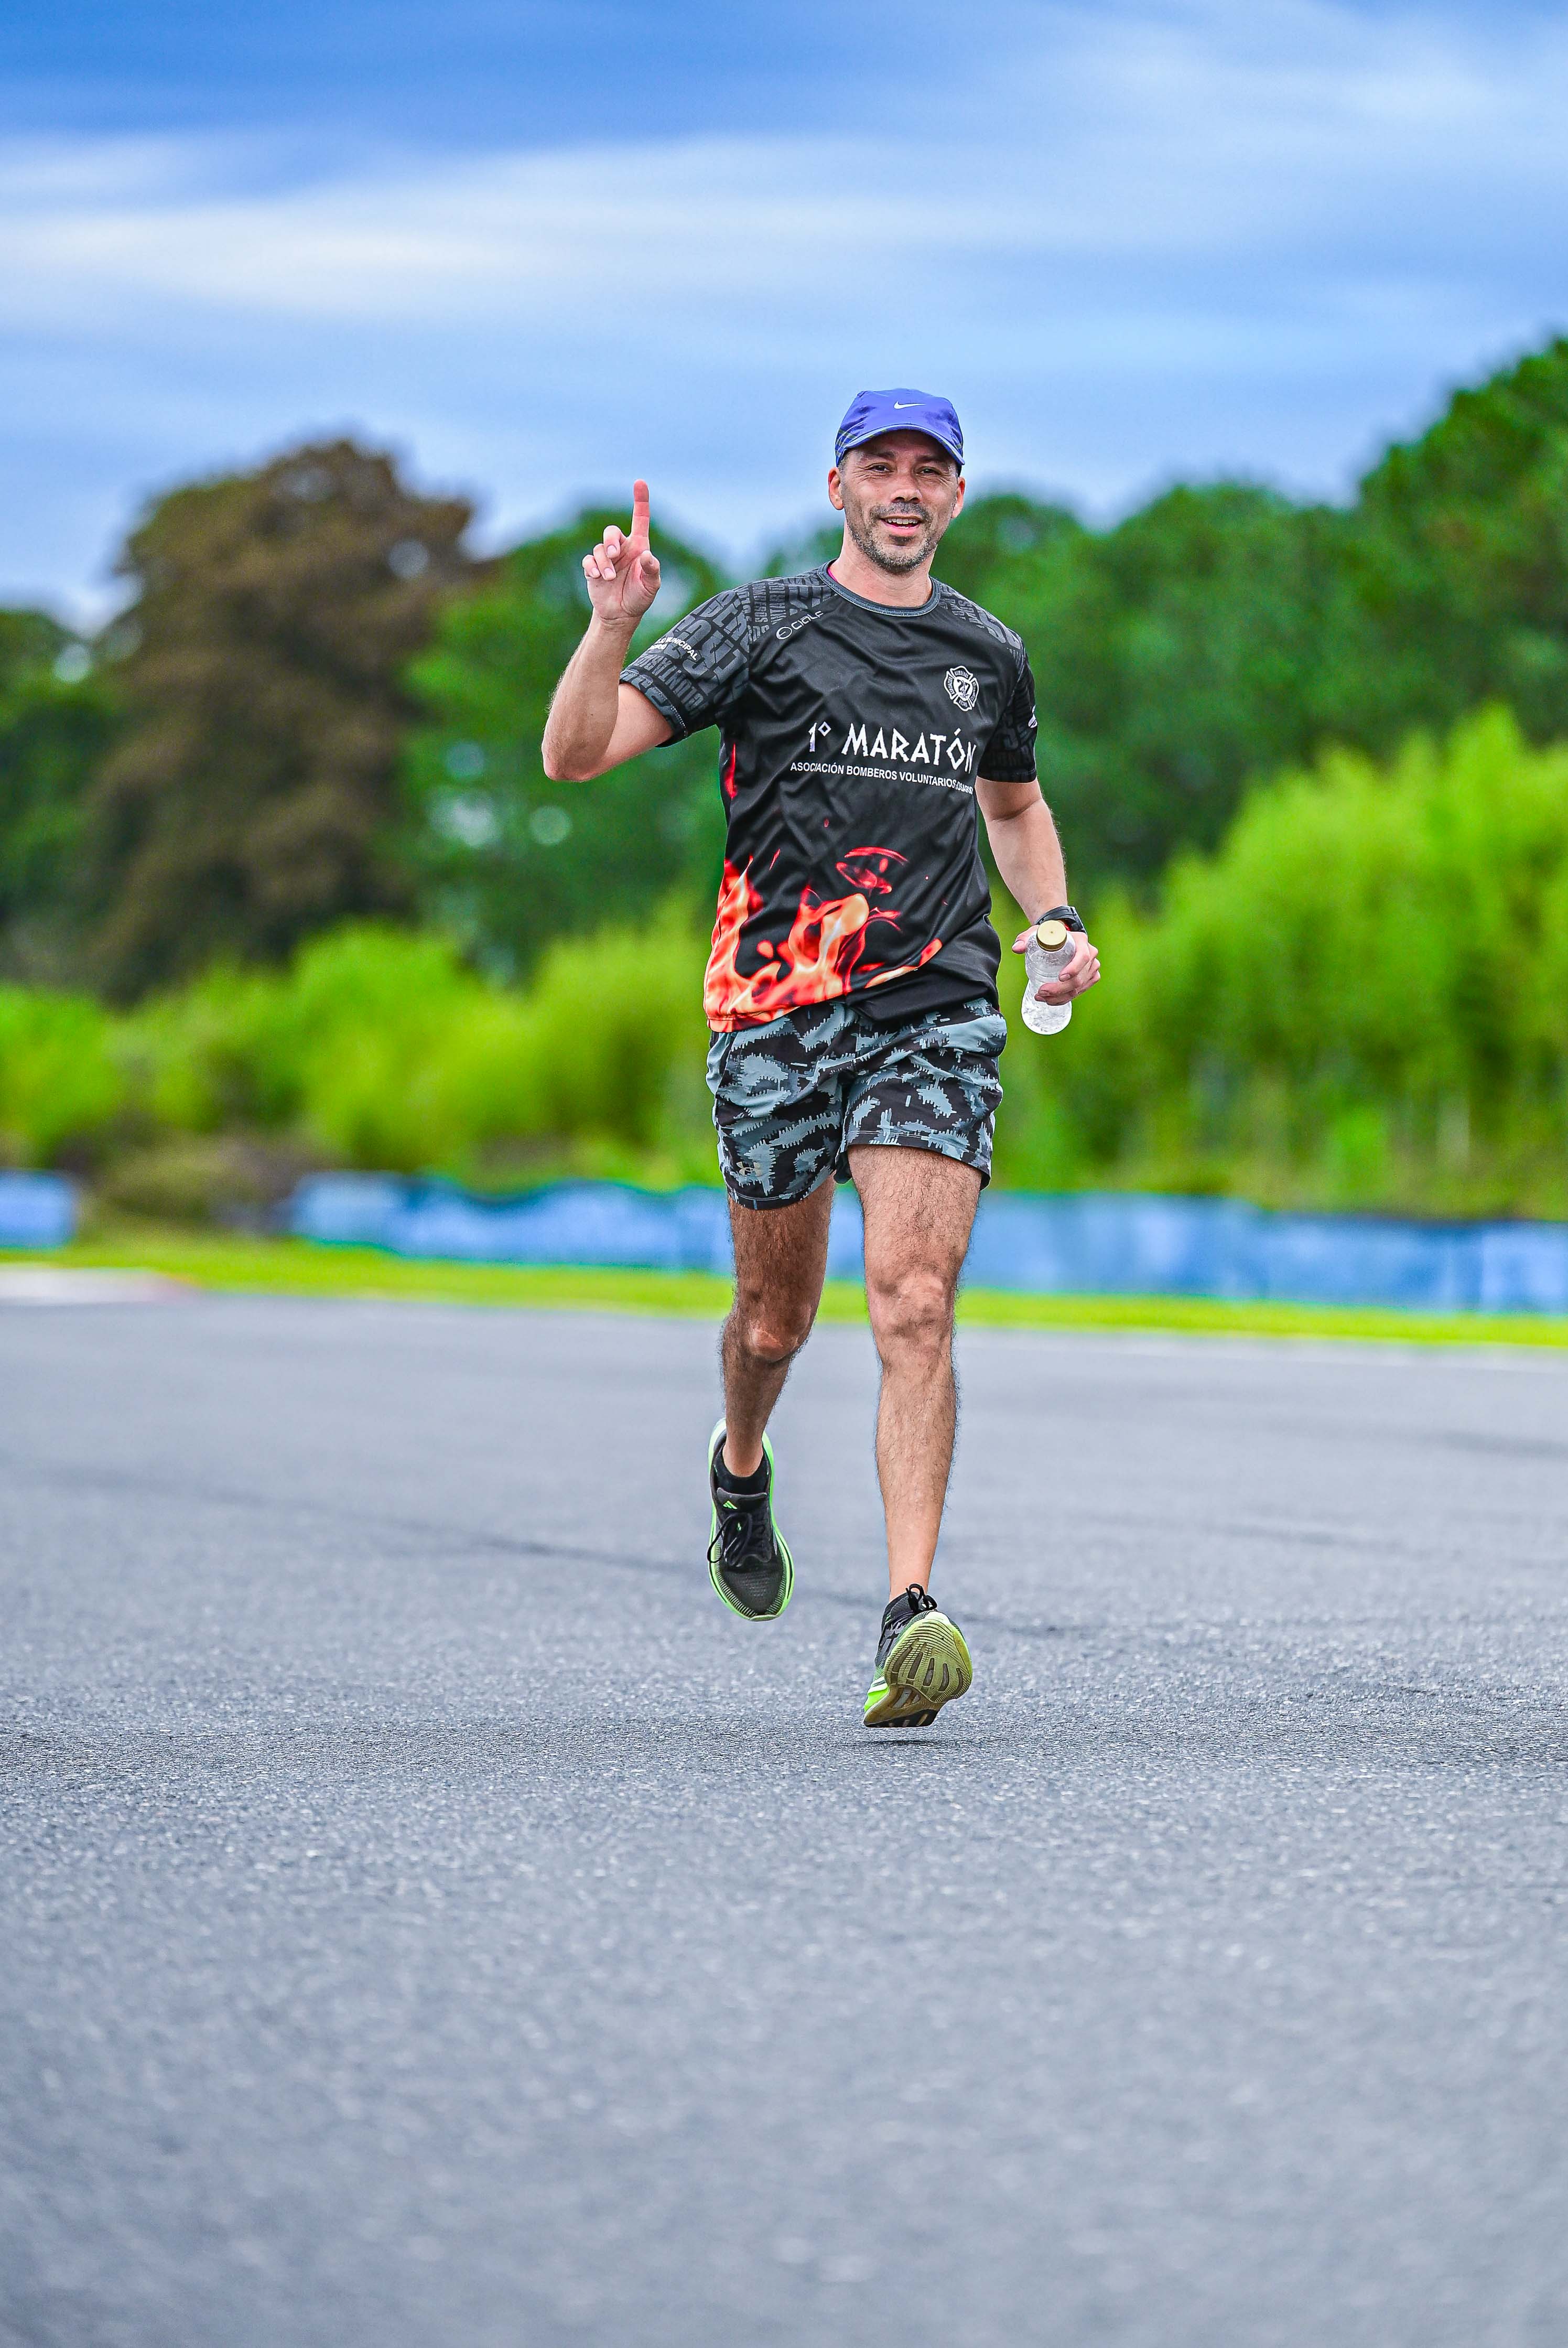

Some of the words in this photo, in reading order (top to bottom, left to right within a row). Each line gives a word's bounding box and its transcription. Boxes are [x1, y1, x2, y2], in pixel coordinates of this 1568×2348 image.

[957, 679, 971, 694] 27
[841, 723, 977, 774] MARATÓN
[790, 762, 844, 774] ASOCIACIÓN
[846, 766, 897, 780] BOMBEROS
[899, 771, 956, 789] VOLUNTARIOS
